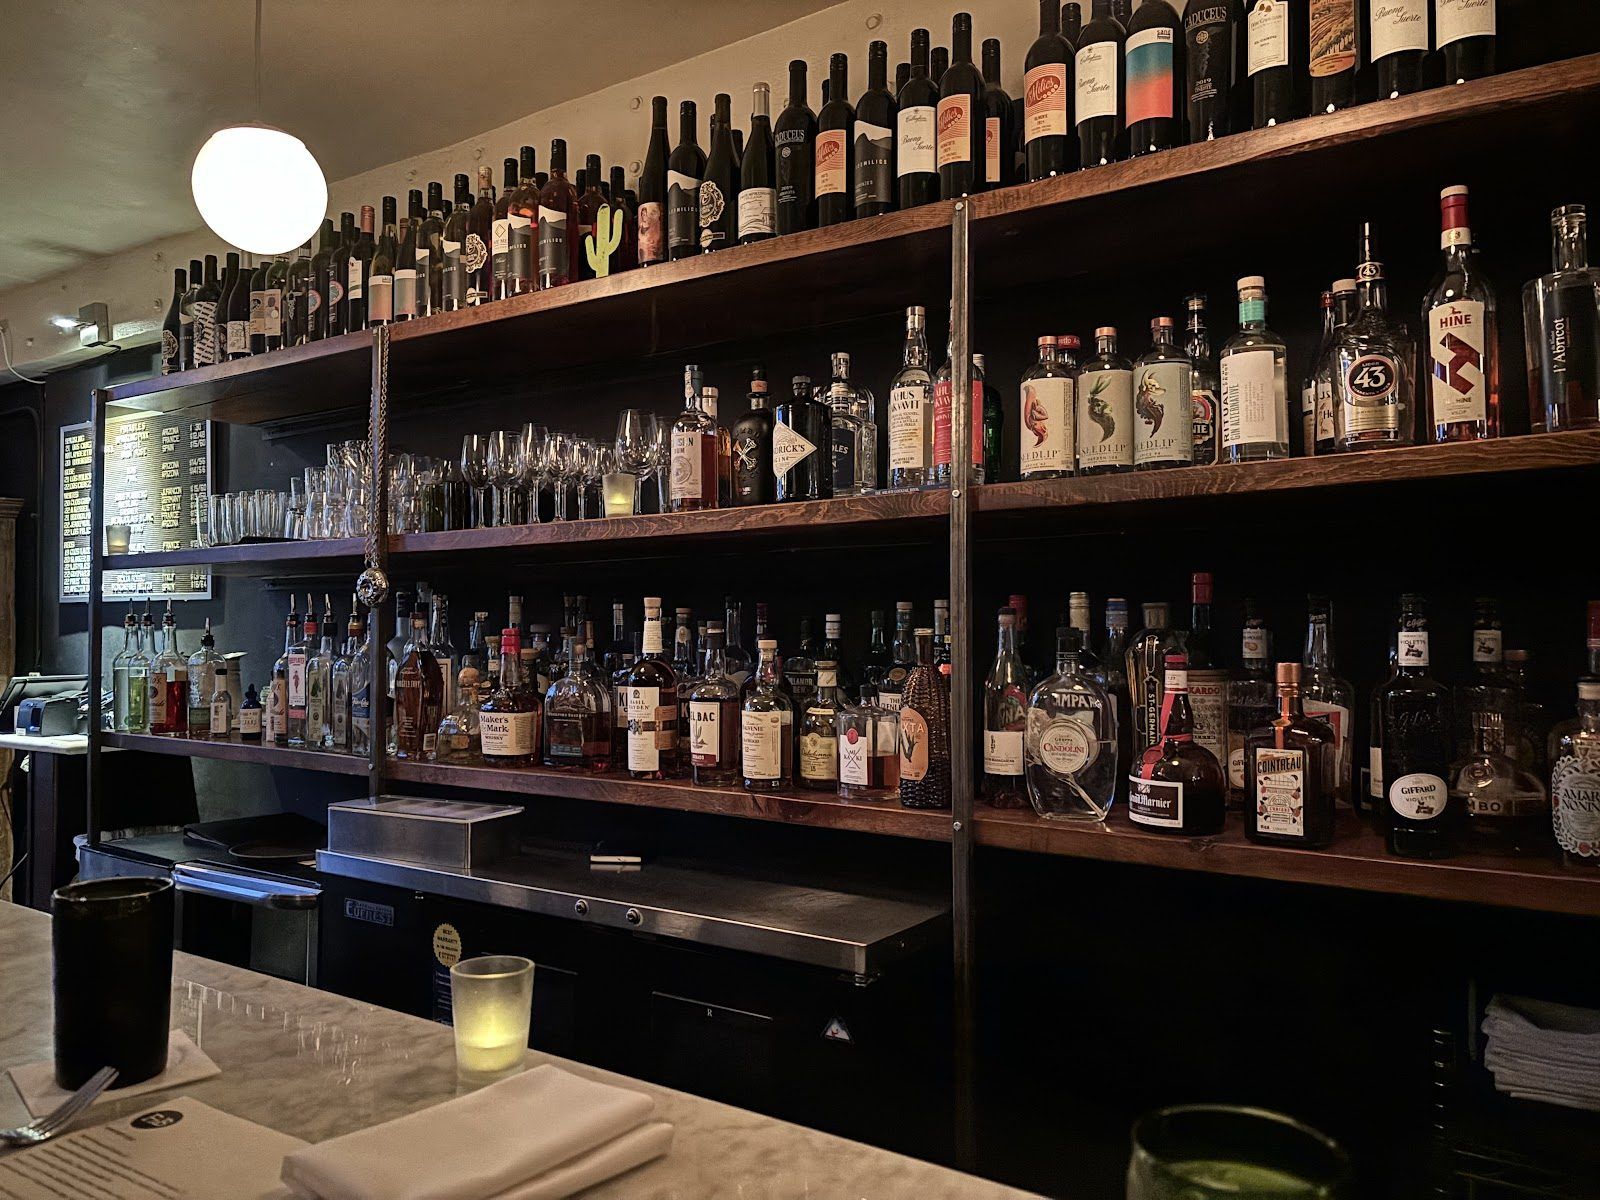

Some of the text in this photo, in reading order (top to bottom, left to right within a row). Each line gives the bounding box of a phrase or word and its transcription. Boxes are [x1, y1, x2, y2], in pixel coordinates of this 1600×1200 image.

[1184, 6, 1227, 29] CADUCEUS
[1374, 5, 1404, 21] Buena
[1392, 11, 1423, 25] Suerte
[1361, 265, 1377, 277] 43
[1439, 314, 1473, 329] HINE
[1352, 365, 1387, 389] 43
[1222, 386, 1230, 443] RITUAL
[1229, 383, 1241, 441] GIN ALTERNATIVE
[774, 444, 806, 455] DRICK'S
[1188, 685, 1222, 695] XARDO
[480, 715, 509, 724] Maker's
[697, 711, 716, 722] BAC
[486, 724, 509, 733] Mark
[902, 721, 925, 733] XTA
[1043, 742, 1085, 754] CANDOLINI
[1256, 755, 1302, 775] COINTREAU
[1401, 784, 1437, 796] GIFFARD
[1562, 787, 1600, 801] AMAR
[1139, 792, 1172, 810] Marnier
[1562, 798, 1600, 813] NONIN
